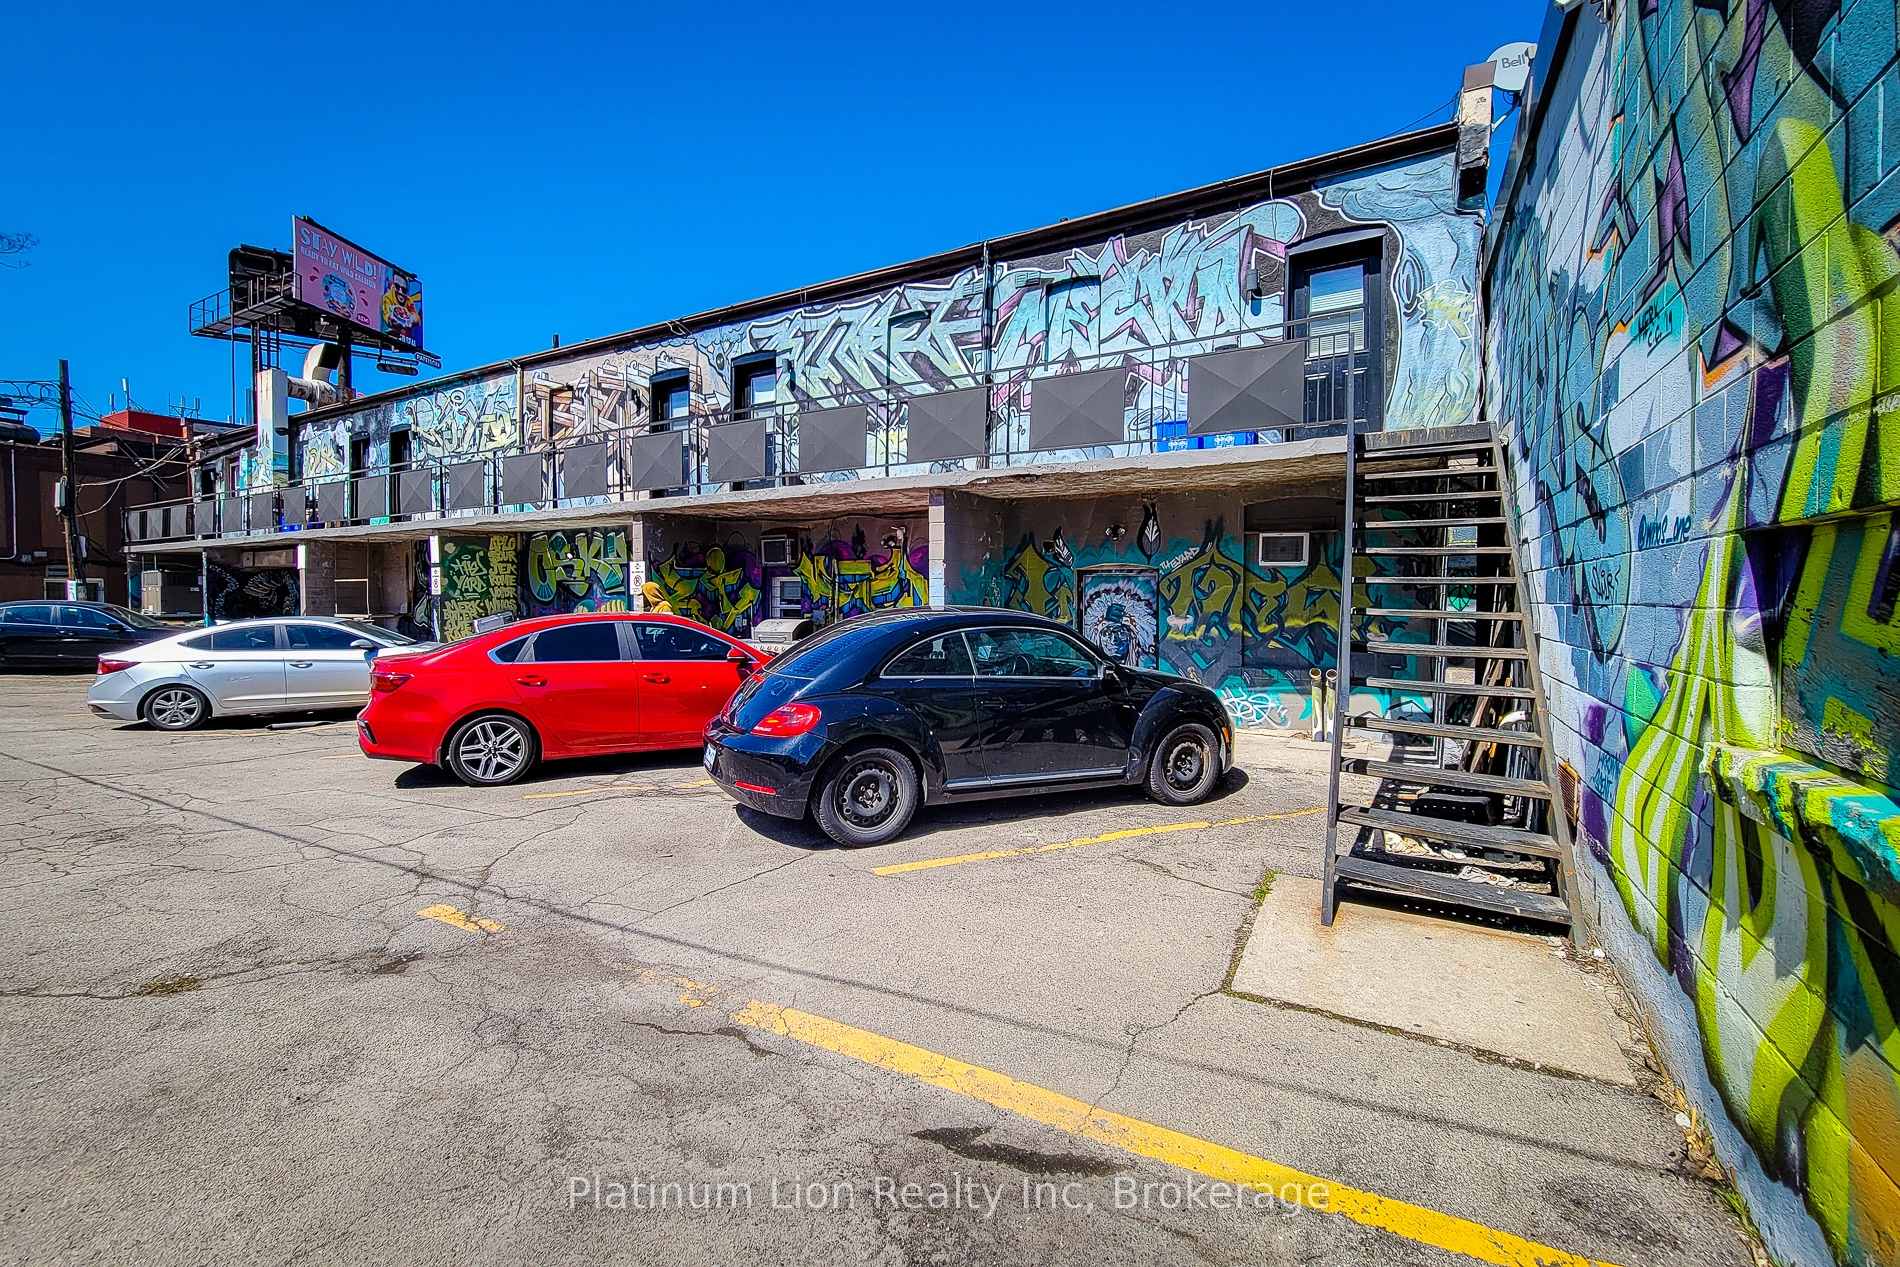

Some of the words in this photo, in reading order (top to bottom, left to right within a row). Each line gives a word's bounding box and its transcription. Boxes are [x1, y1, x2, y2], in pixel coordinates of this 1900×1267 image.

[1502, 54, 1526, 69] Bell
[300, 224, 338, 258] STAY
[453, 575, 488, 593] YARD
